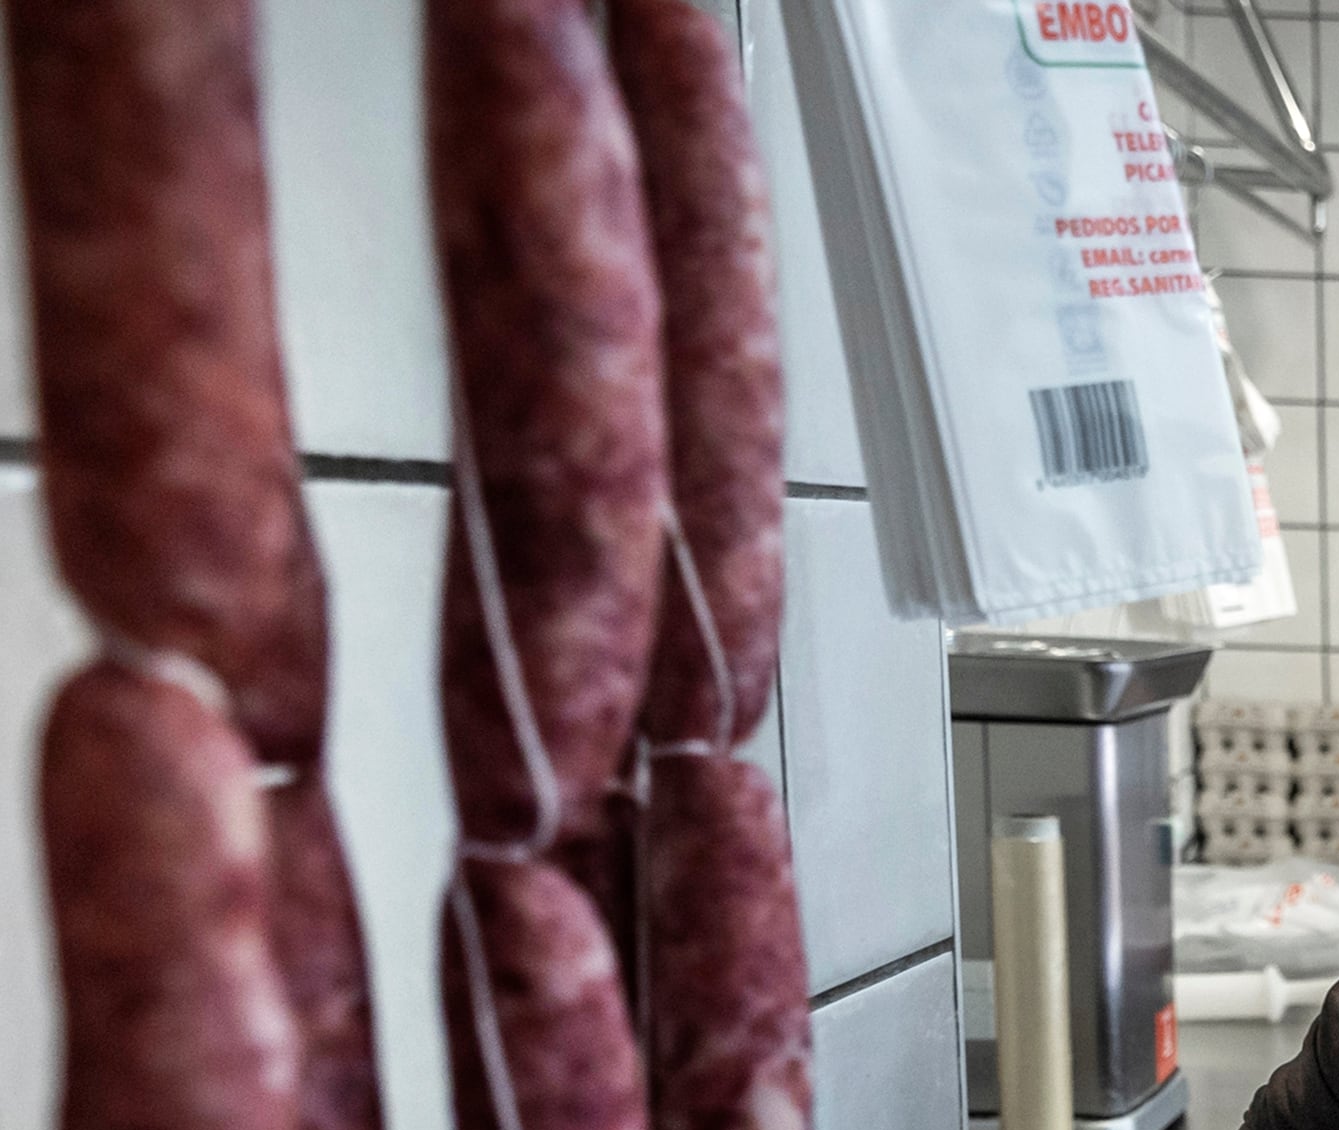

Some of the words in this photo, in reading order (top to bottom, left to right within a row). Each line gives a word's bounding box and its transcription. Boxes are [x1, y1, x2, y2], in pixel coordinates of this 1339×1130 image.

[1035, 3, 1130, 42] EMBO
[1055, 217, 1140, 237] PEDIDOS
[1145, 214, 1181, 234] POR
